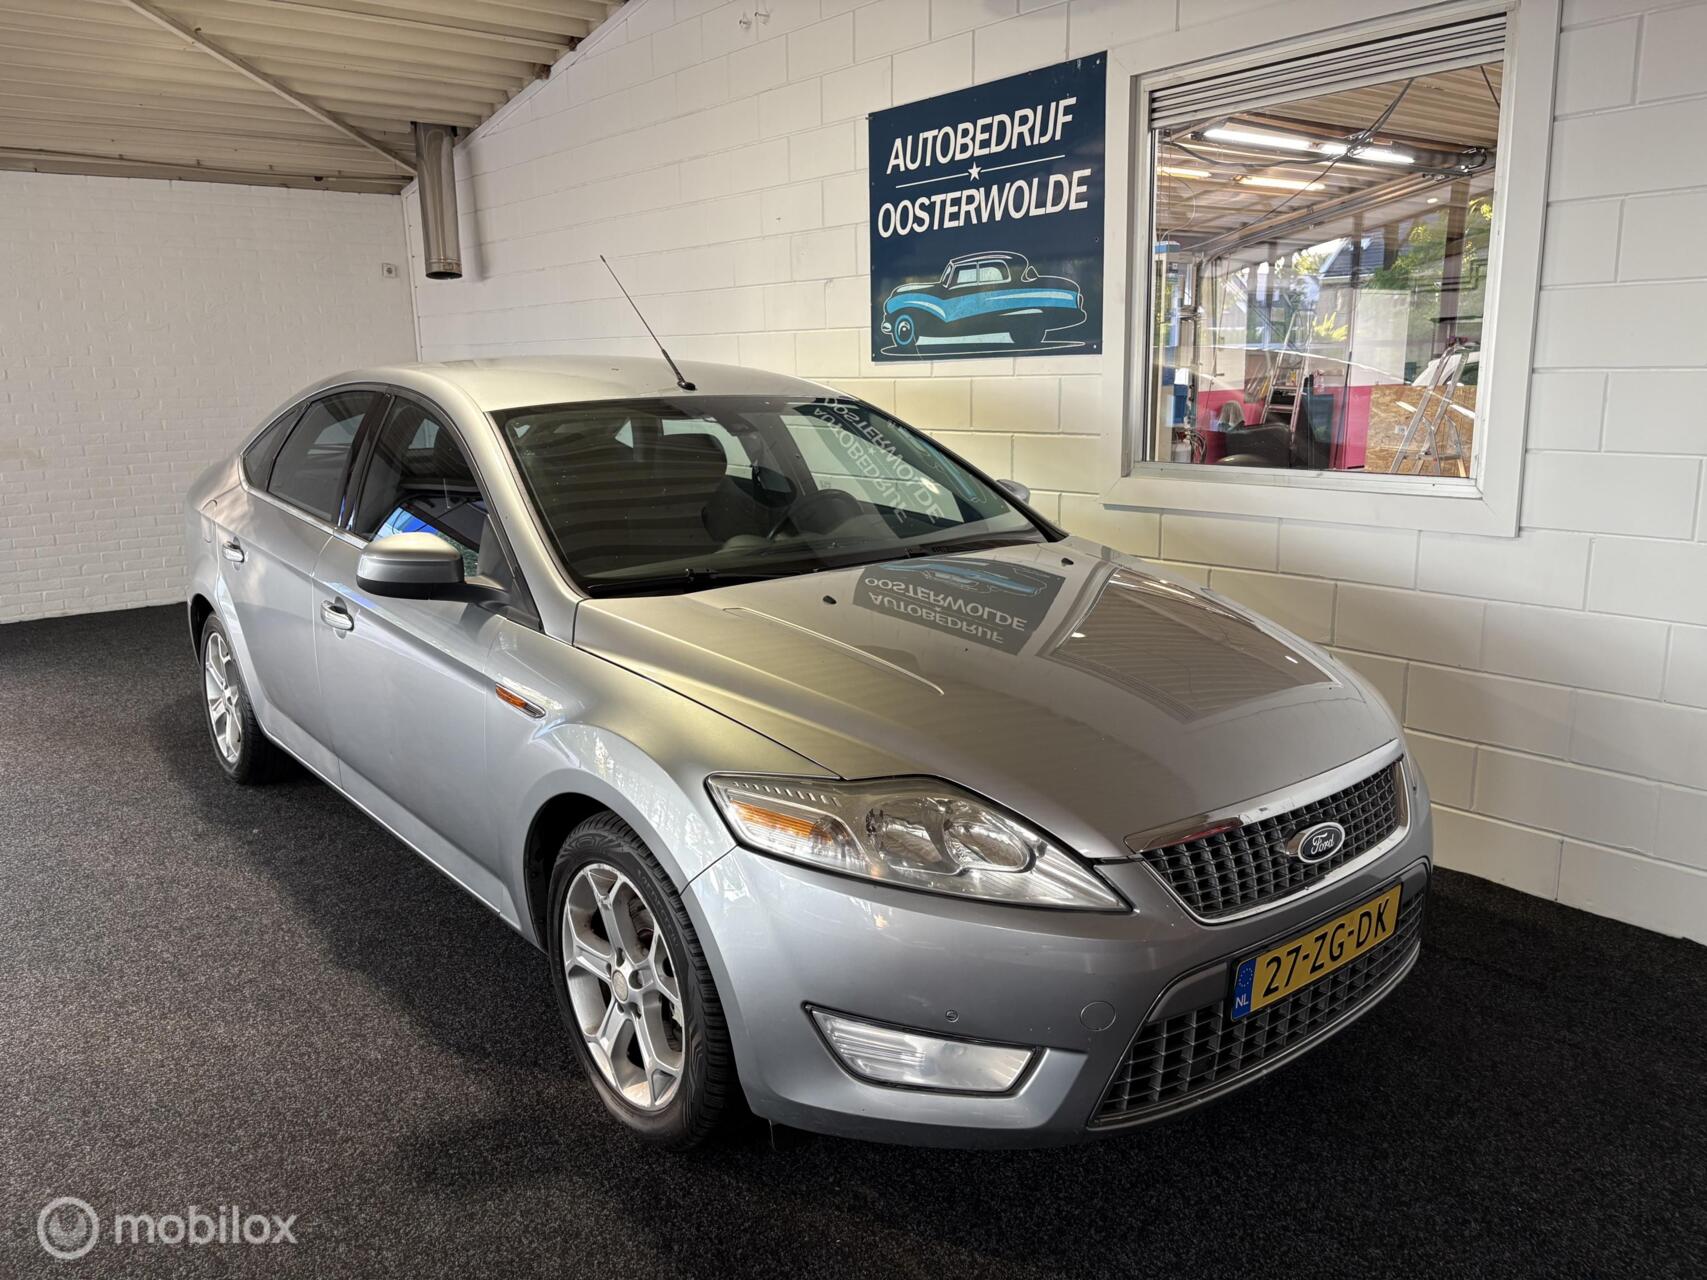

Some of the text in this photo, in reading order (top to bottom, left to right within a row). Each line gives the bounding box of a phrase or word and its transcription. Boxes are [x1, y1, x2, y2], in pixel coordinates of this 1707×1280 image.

[886, 96, 1077, 175] AUTOBEDRIJF
[878, 168, 1092, 239] OOSTERWOLDE
[1310, 832, 1335, 855] Ford
[1263, 898, 1390, 999] 27-ZG-DK
[1235, 994, 1249, 1009] NL
